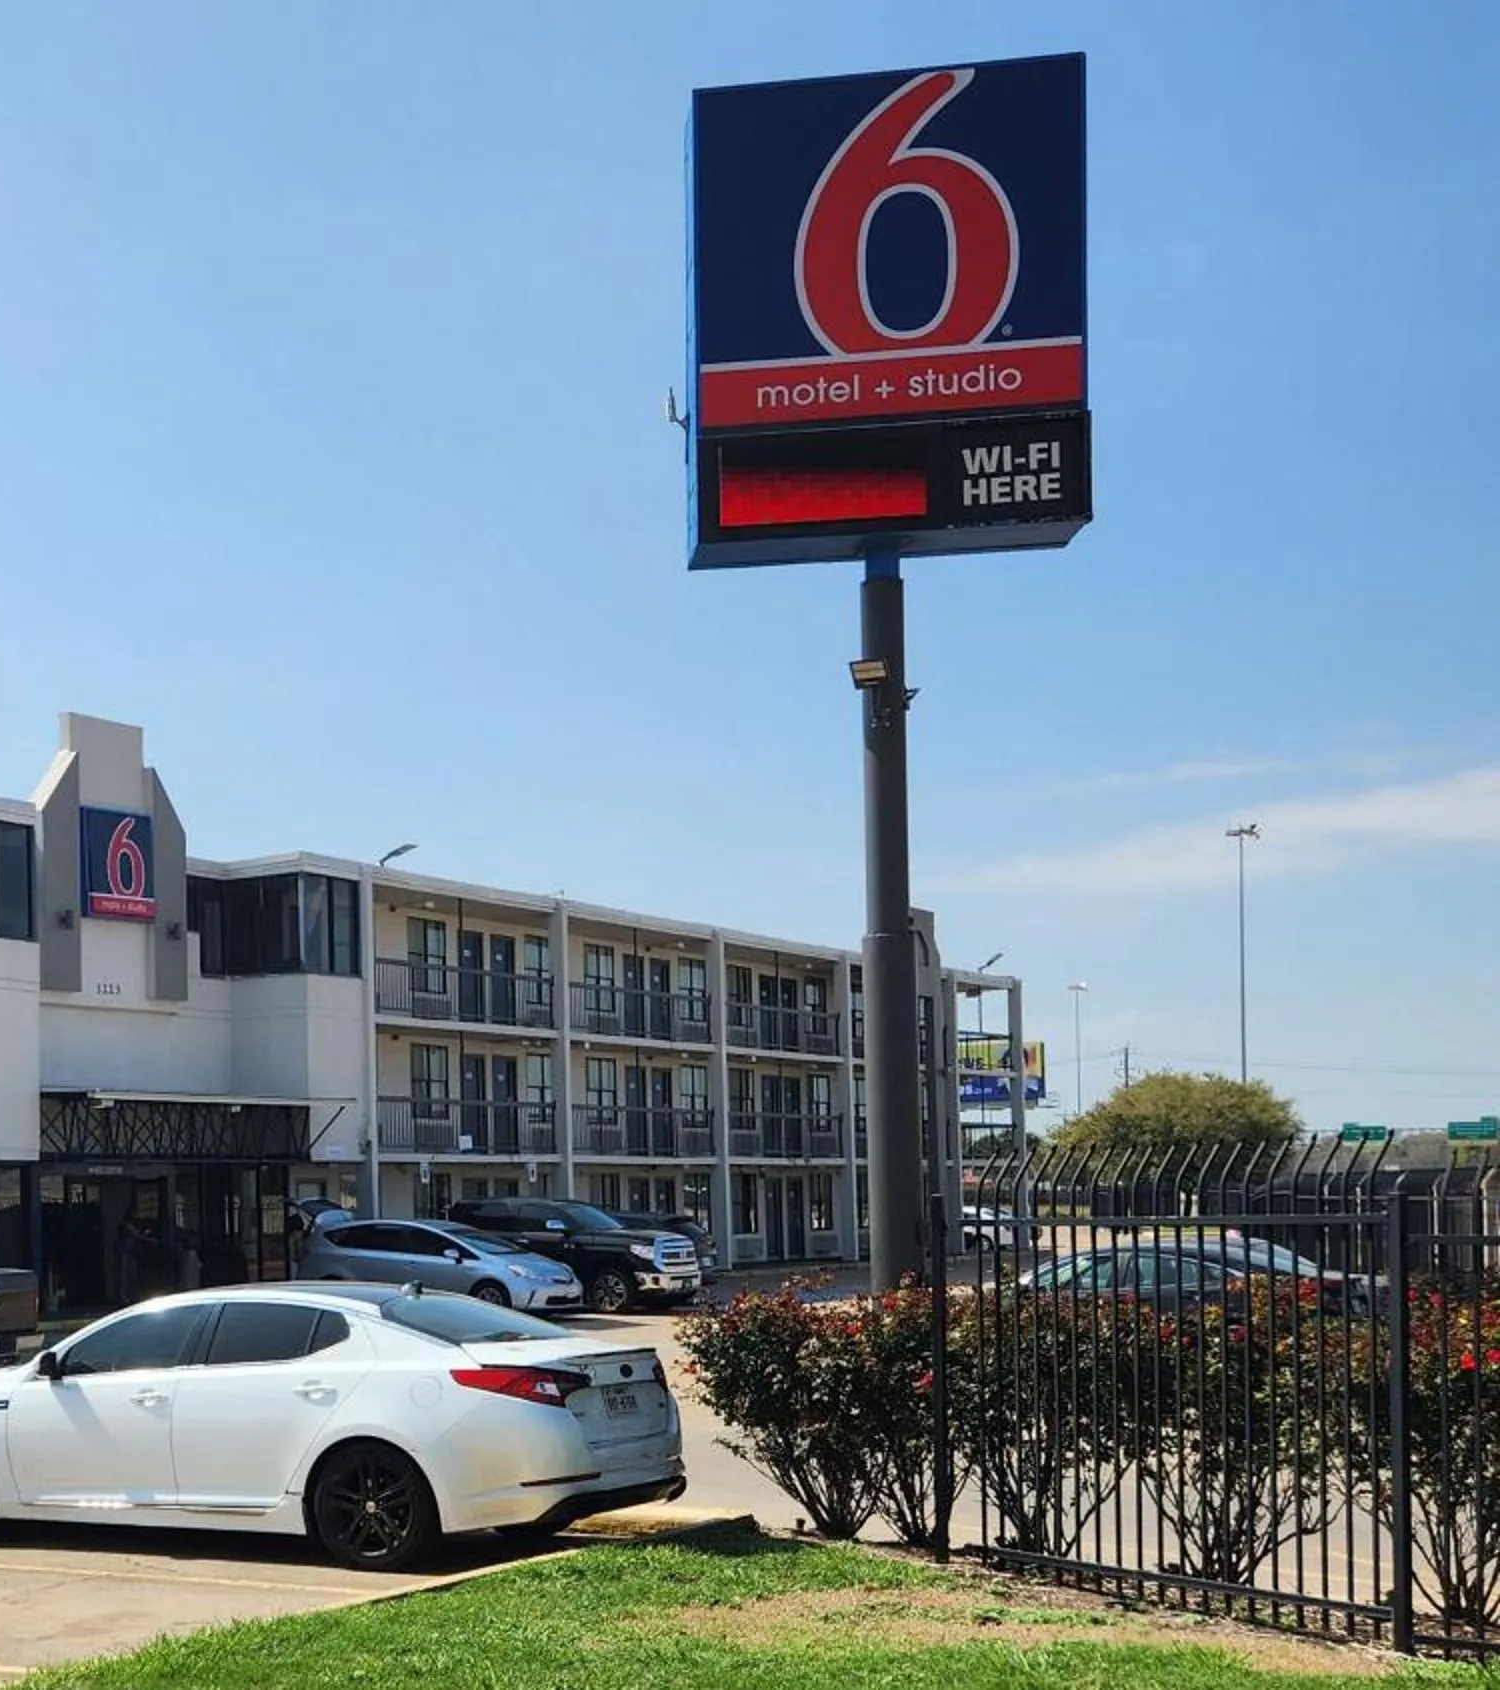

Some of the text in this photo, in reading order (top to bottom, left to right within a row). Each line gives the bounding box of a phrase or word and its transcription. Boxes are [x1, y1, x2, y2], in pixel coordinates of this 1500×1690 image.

[793, 66, 1020, 356] 6
[755, 364, 1024, 409] motel + studio
[961, 440, 1062, 476] WI-FI
[962, 472, 1063, 507] HERE
[107, 817, 145, 898] 6
